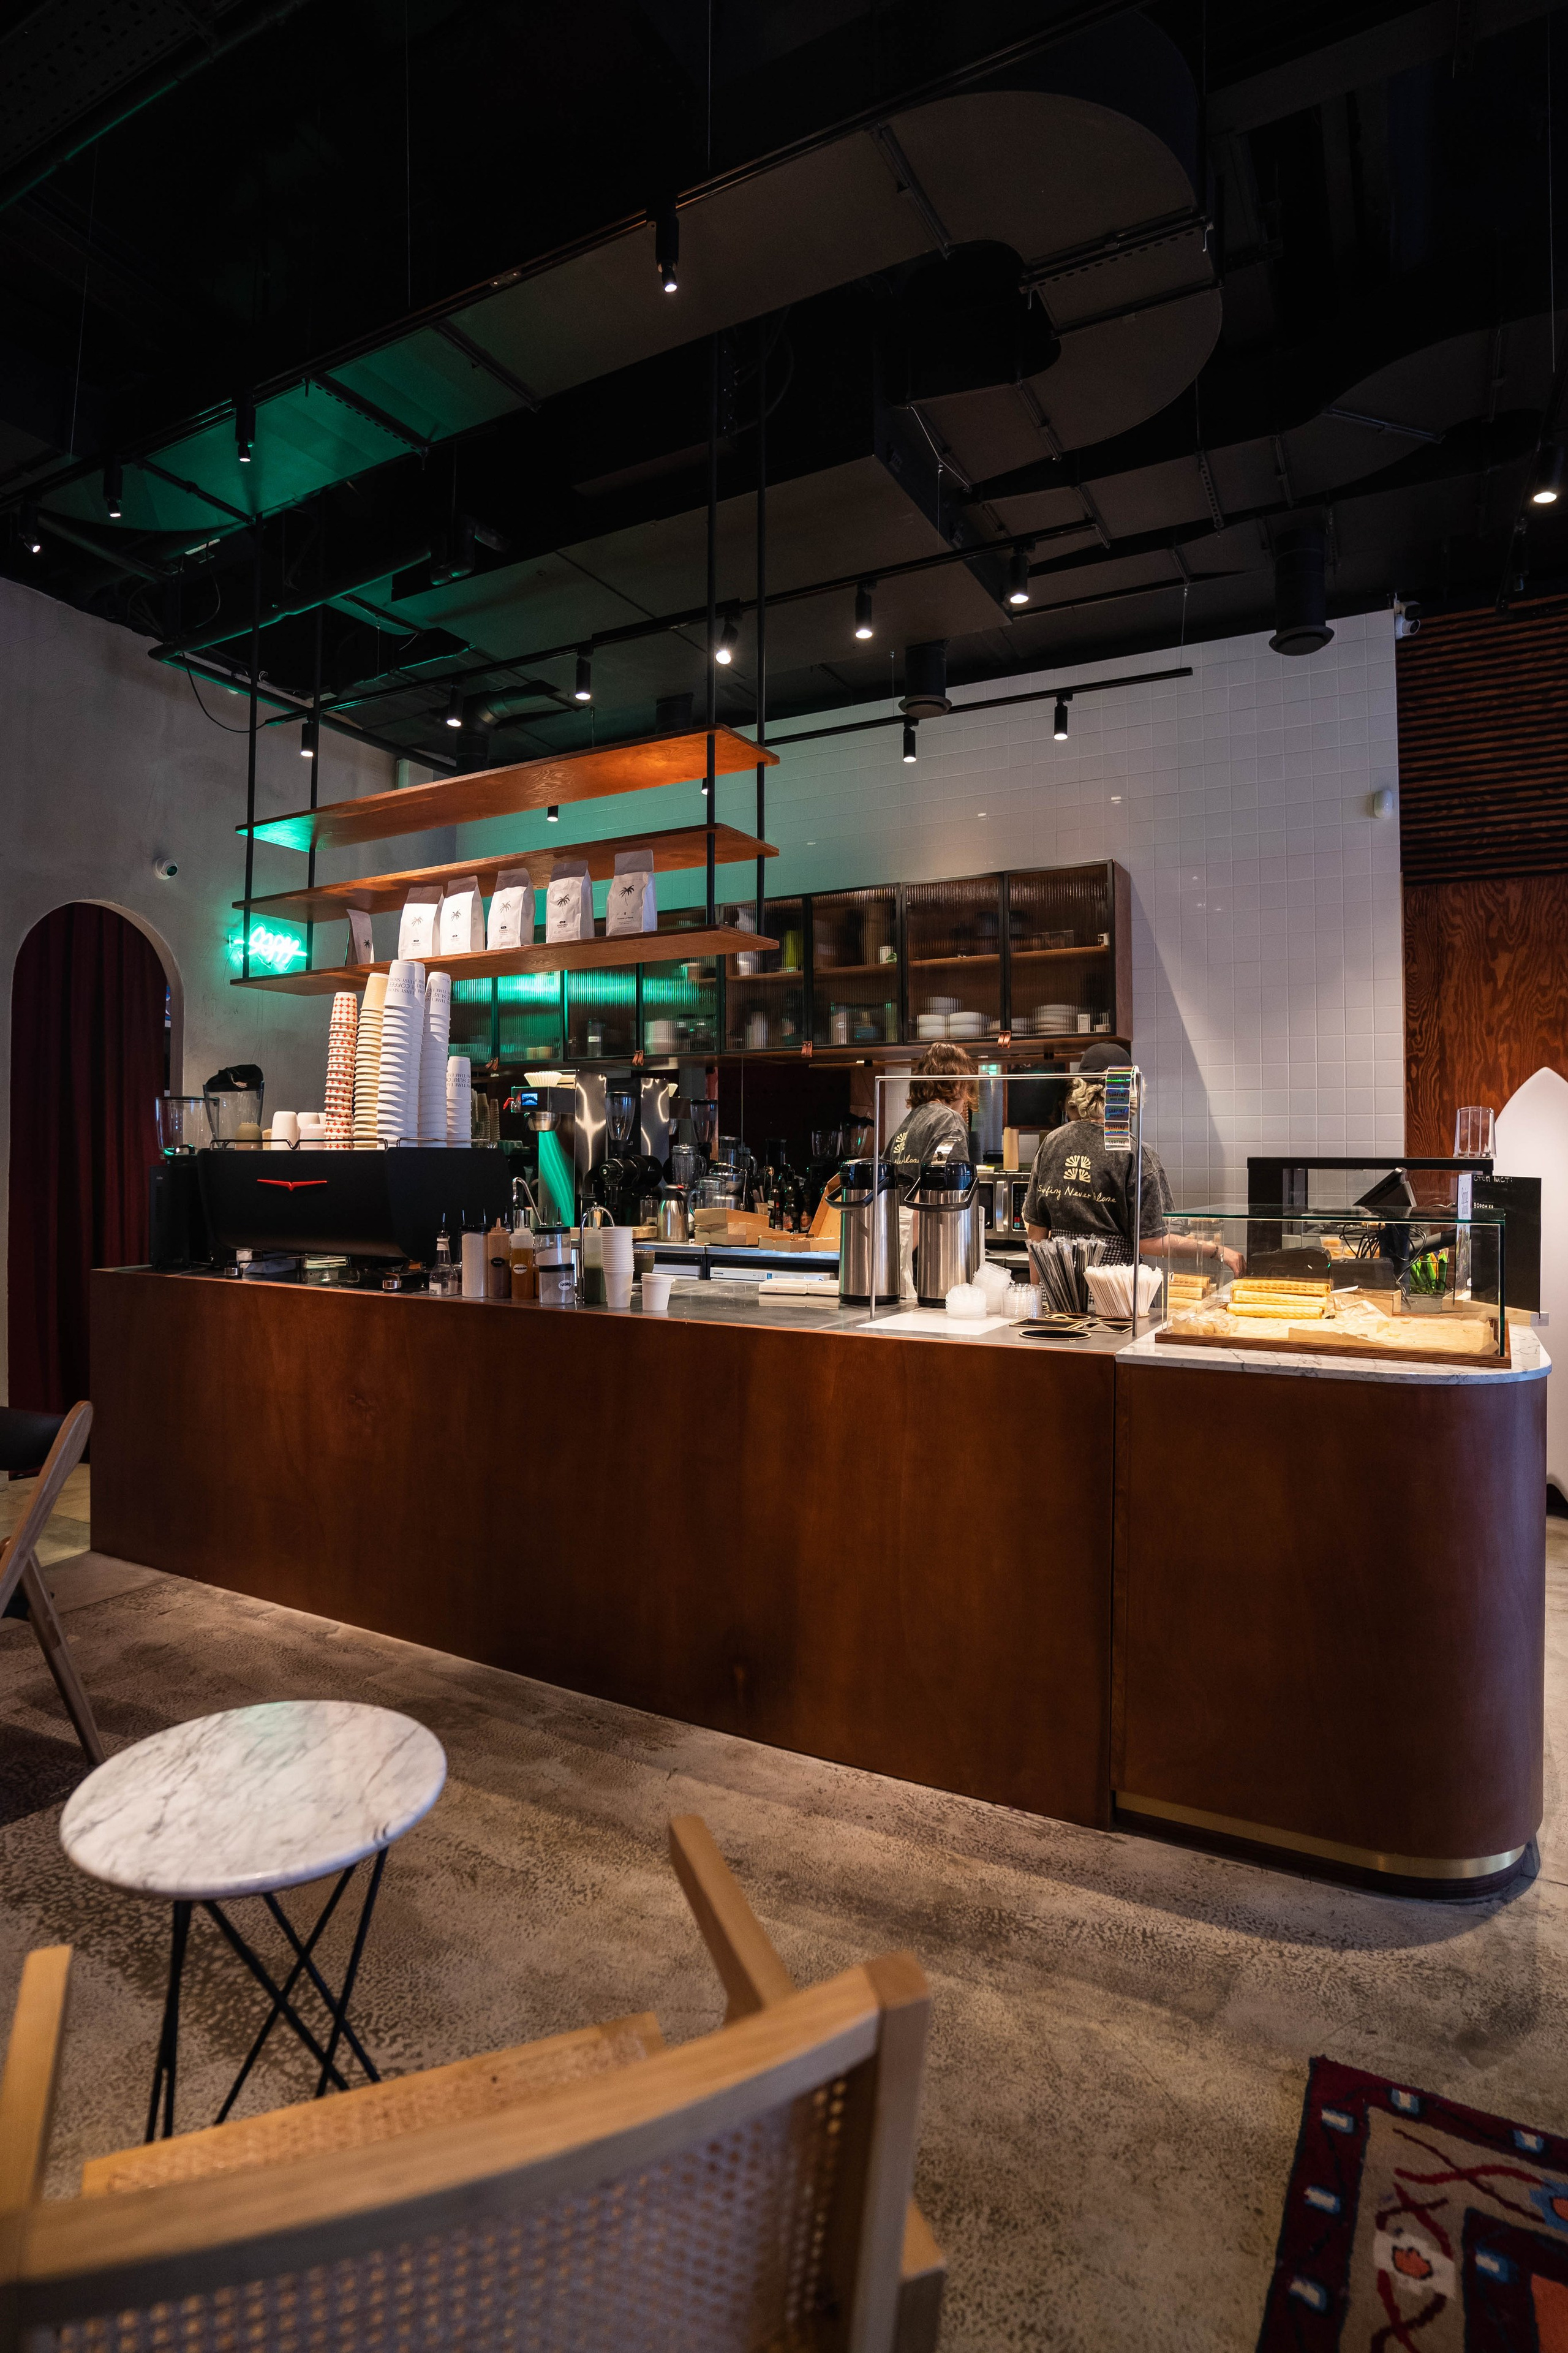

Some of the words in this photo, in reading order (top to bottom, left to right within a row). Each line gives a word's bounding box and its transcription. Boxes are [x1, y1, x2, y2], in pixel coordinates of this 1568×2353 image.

[1038, 1185, 1061, 1201] Surfing
[1064, 1186, 1091, 1199] Never
[1092, 1192, 1117, 1203] Alone
